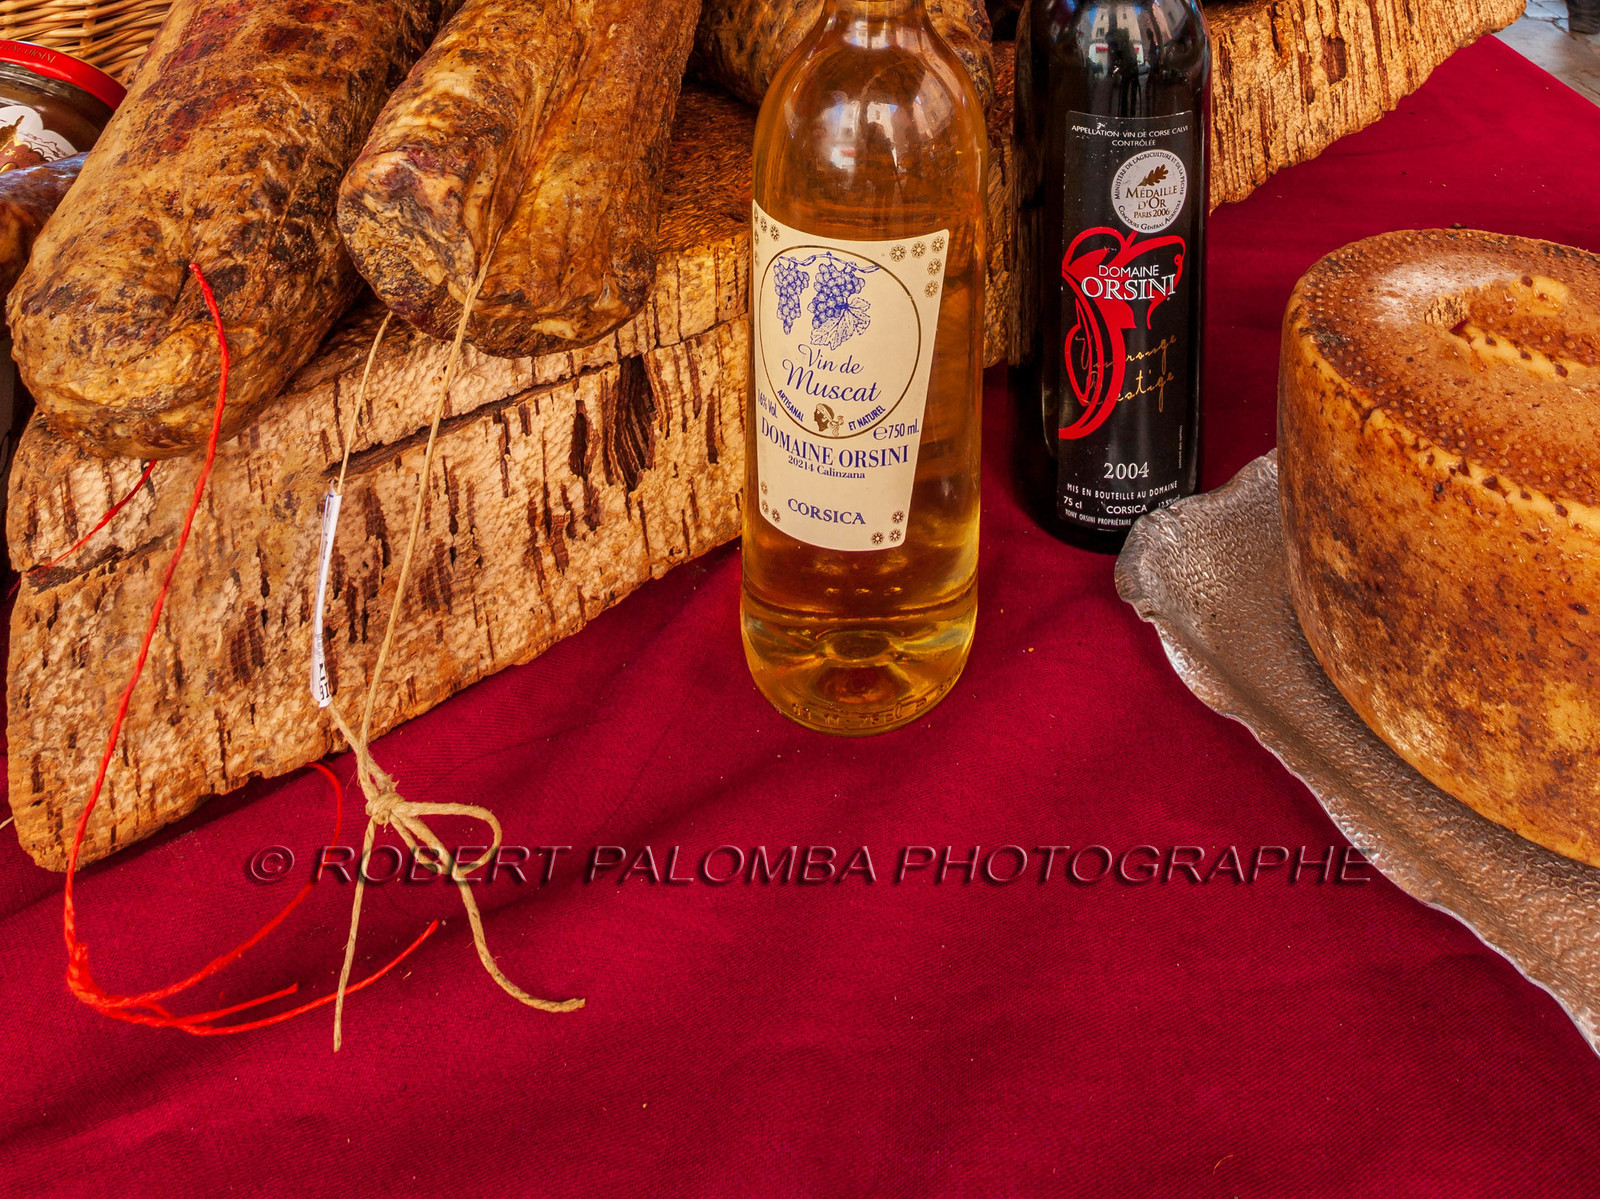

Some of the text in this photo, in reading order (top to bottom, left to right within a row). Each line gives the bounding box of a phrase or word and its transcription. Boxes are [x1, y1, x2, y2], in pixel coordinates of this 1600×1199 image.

[1071, 125, 1120, 138] APPELLATION
[1111, 138, 1157, 148] CONTRÔLÉE
[1125, 185, 1178, 199] MÉDAILLE
[1137, 196, 1167, 210] D'OR
[1133, 207, 1170, 219] PARIS 2006
[1098, 264, 1160, 277] DOMAINE
[1081, 273, 1176, 301] ORSINI
[797, 343, 864, 375] Vin de
[782, 359, 882, 402] Muscat
[777, 389, 886, 432] ARTISANAL ET NATUREL
[761, 416, 909, 468] DOMAINE ORSINI
[788, 455, 866, 480] 20214 Calinzana
[1103, 461, 1150, 480] 2004
[1067, 480, 1178, 501] MIS EN BOUTEILLE AU DOMAINE
[1063, 495, 1083, 509] 75 cl
[1106, 504, 1148, 515] CORSICA
[788, 498, 867, 525] CORSICA
[1065, 508, 1132, 526] TONY ORSINI PROPRIÉTAIRE
